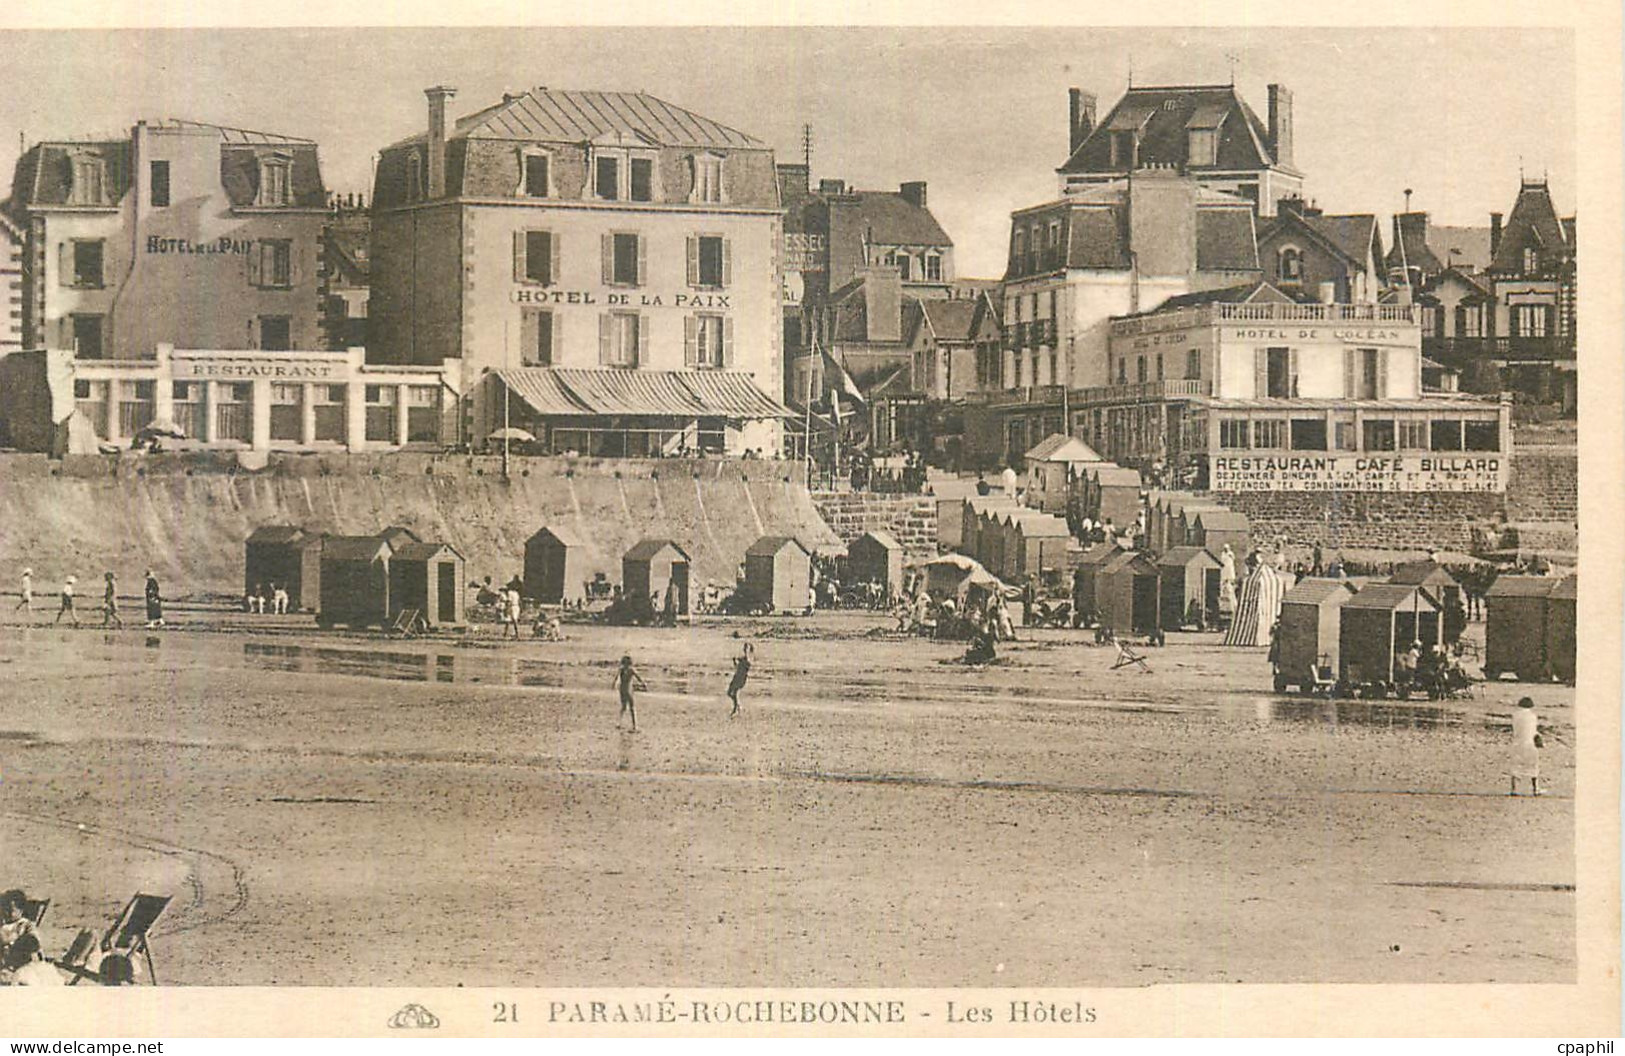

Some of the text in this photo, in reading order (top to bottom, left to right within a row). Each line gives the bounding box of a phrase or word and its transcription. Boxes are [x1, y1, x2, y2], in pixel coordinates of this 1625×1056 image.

[147, 235, 193, 254] HOTEL
[517, 291, 731, 308] HOTEL DE LA PAIX
[1236, 329, 1287, 339] HOTEL
[1299, 330, 1317, 339] DE
[193, 365, 332, 377] RESTAURANT
[1216, 458, 1337, 470] RESTAURANT
[1421, 459, 1499, 471] BILLARD
